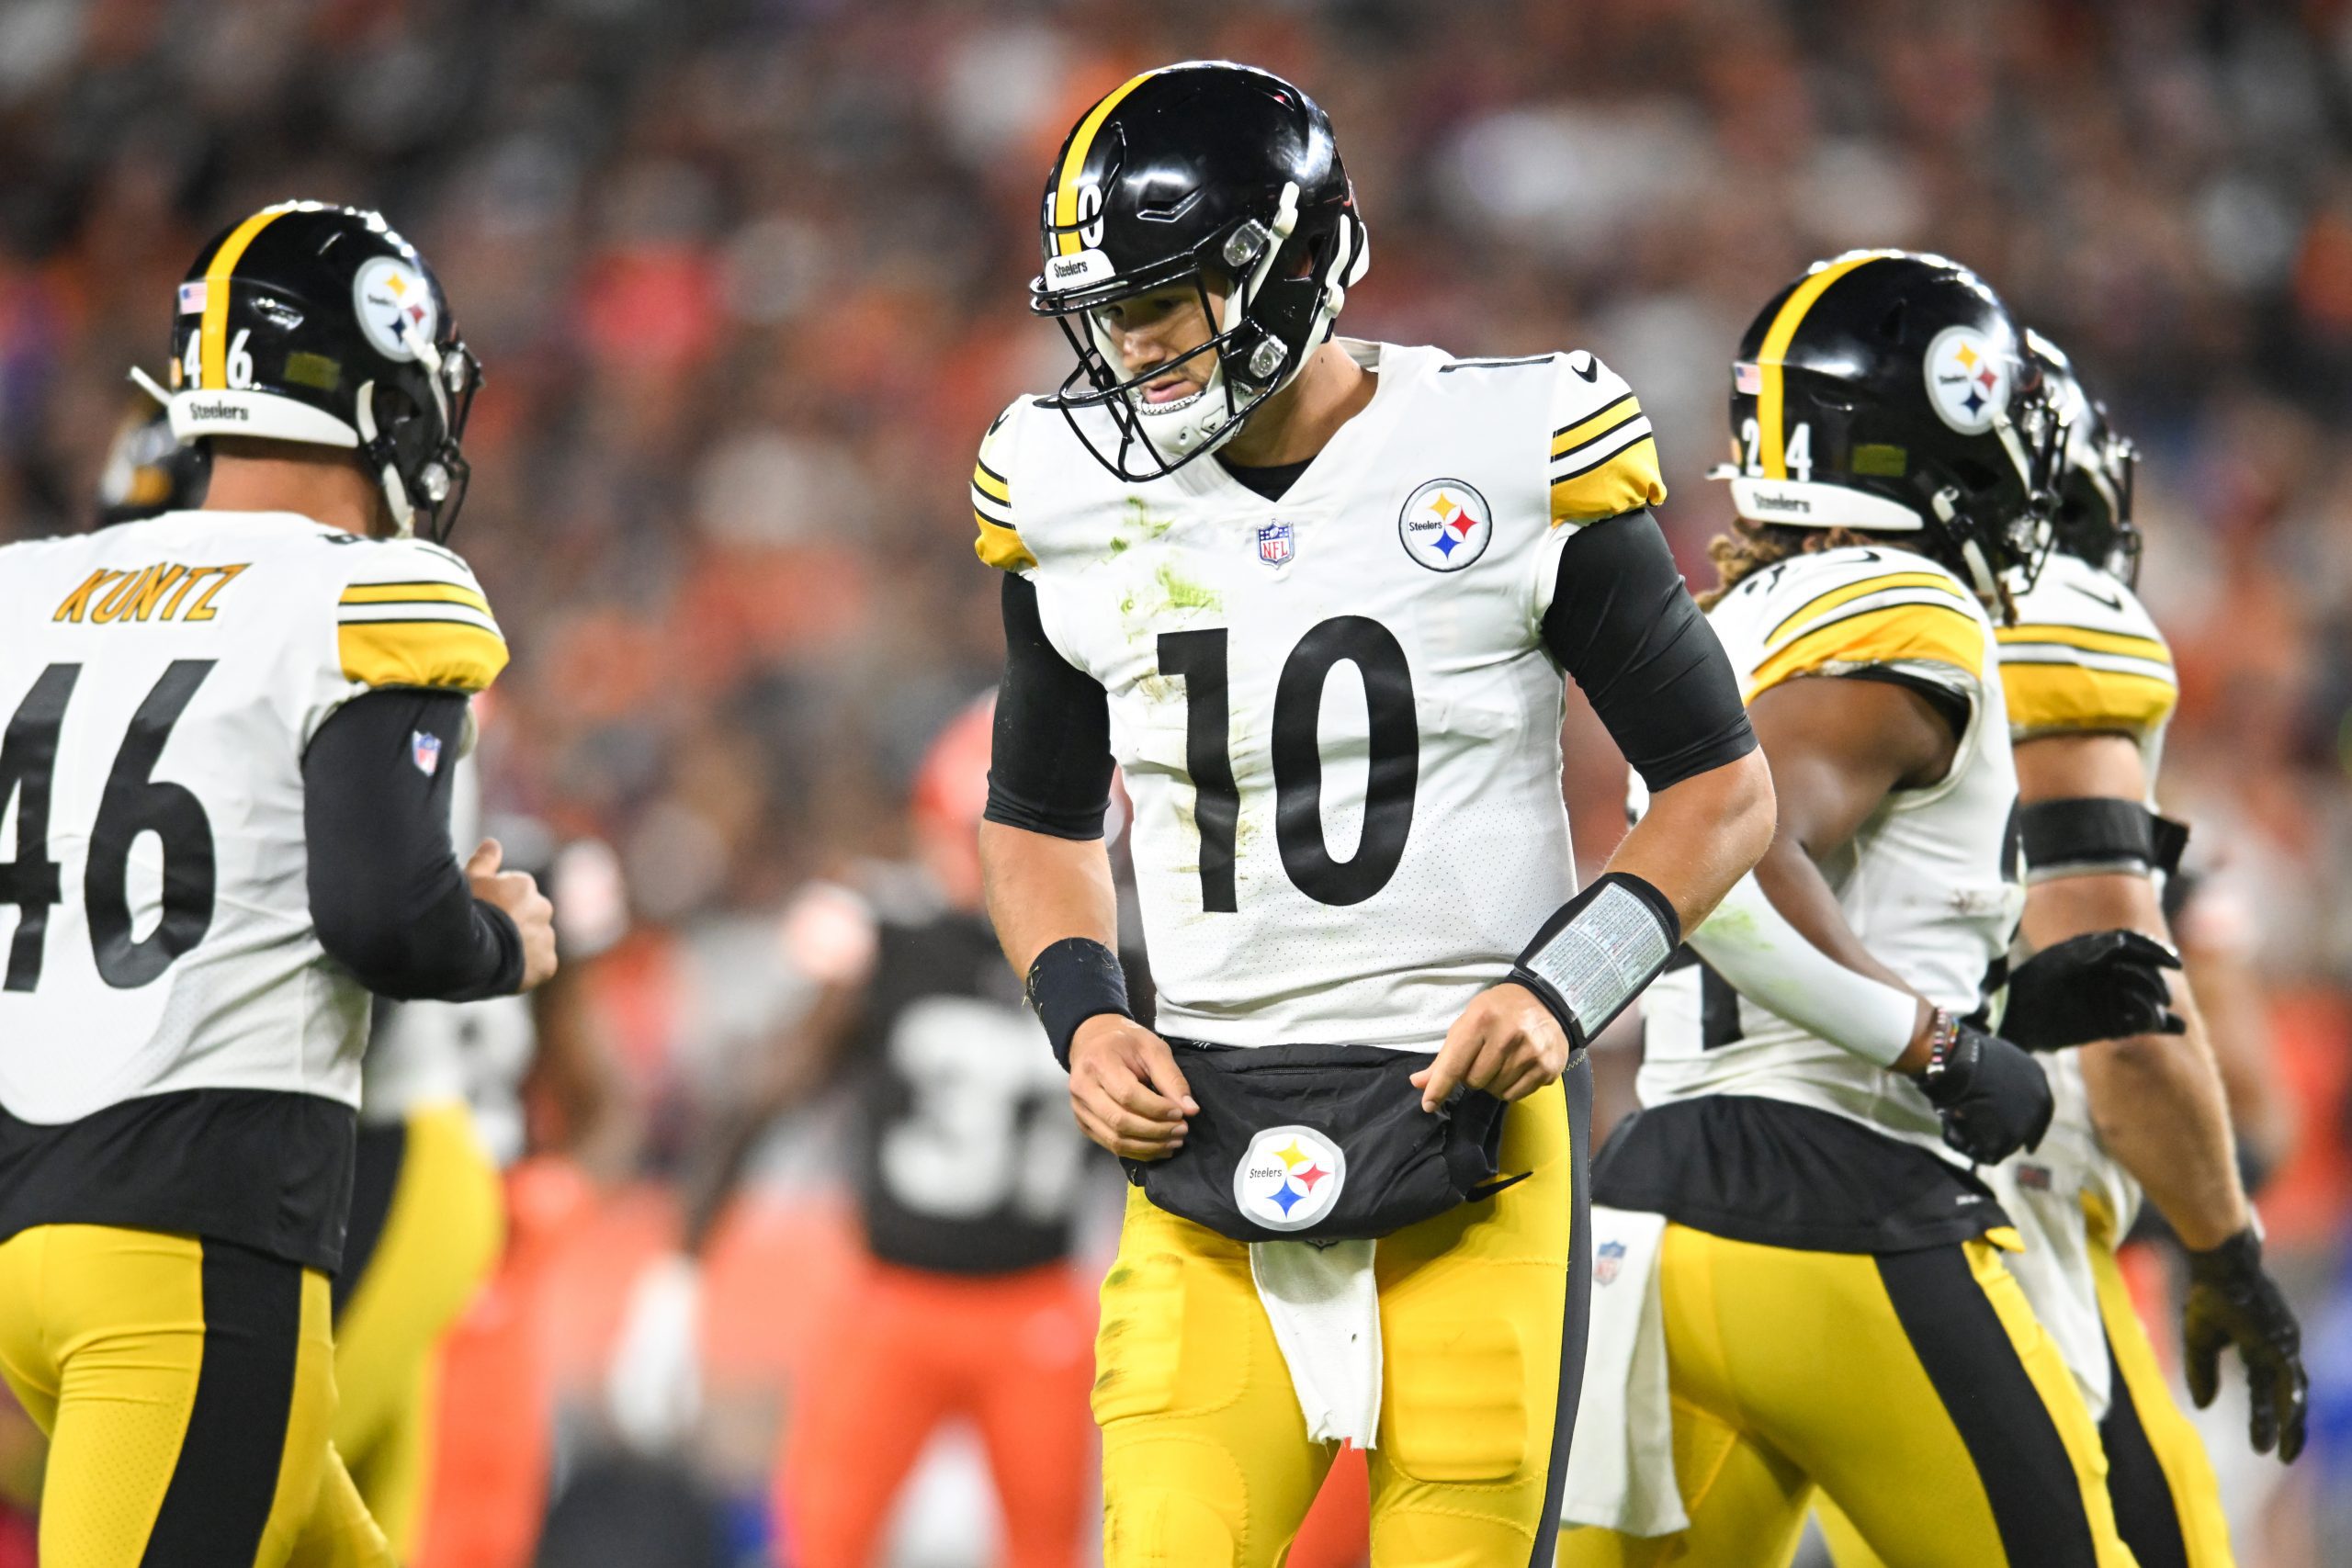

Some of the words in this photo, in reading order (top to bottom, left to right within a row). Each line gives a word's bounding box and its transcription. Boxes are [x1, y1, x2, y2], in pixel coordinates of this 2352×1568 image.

[1054, 261, 1089, 278] Steelers
[184, 328, 254, 390] 46
[189, 400, 250, 421] Steelers
[1742, 416, 1813, 481] 24
[1408, 520, 1442, 532] Steelers
[1262, 541, 1288, 559] NFL
[51, 561, 253, 624] KUNTZ
[1157, 615, 1419, 913] 10
[0, 659, 220, 993] 46
[1250, 1168, 1283, 1179] Steelers
